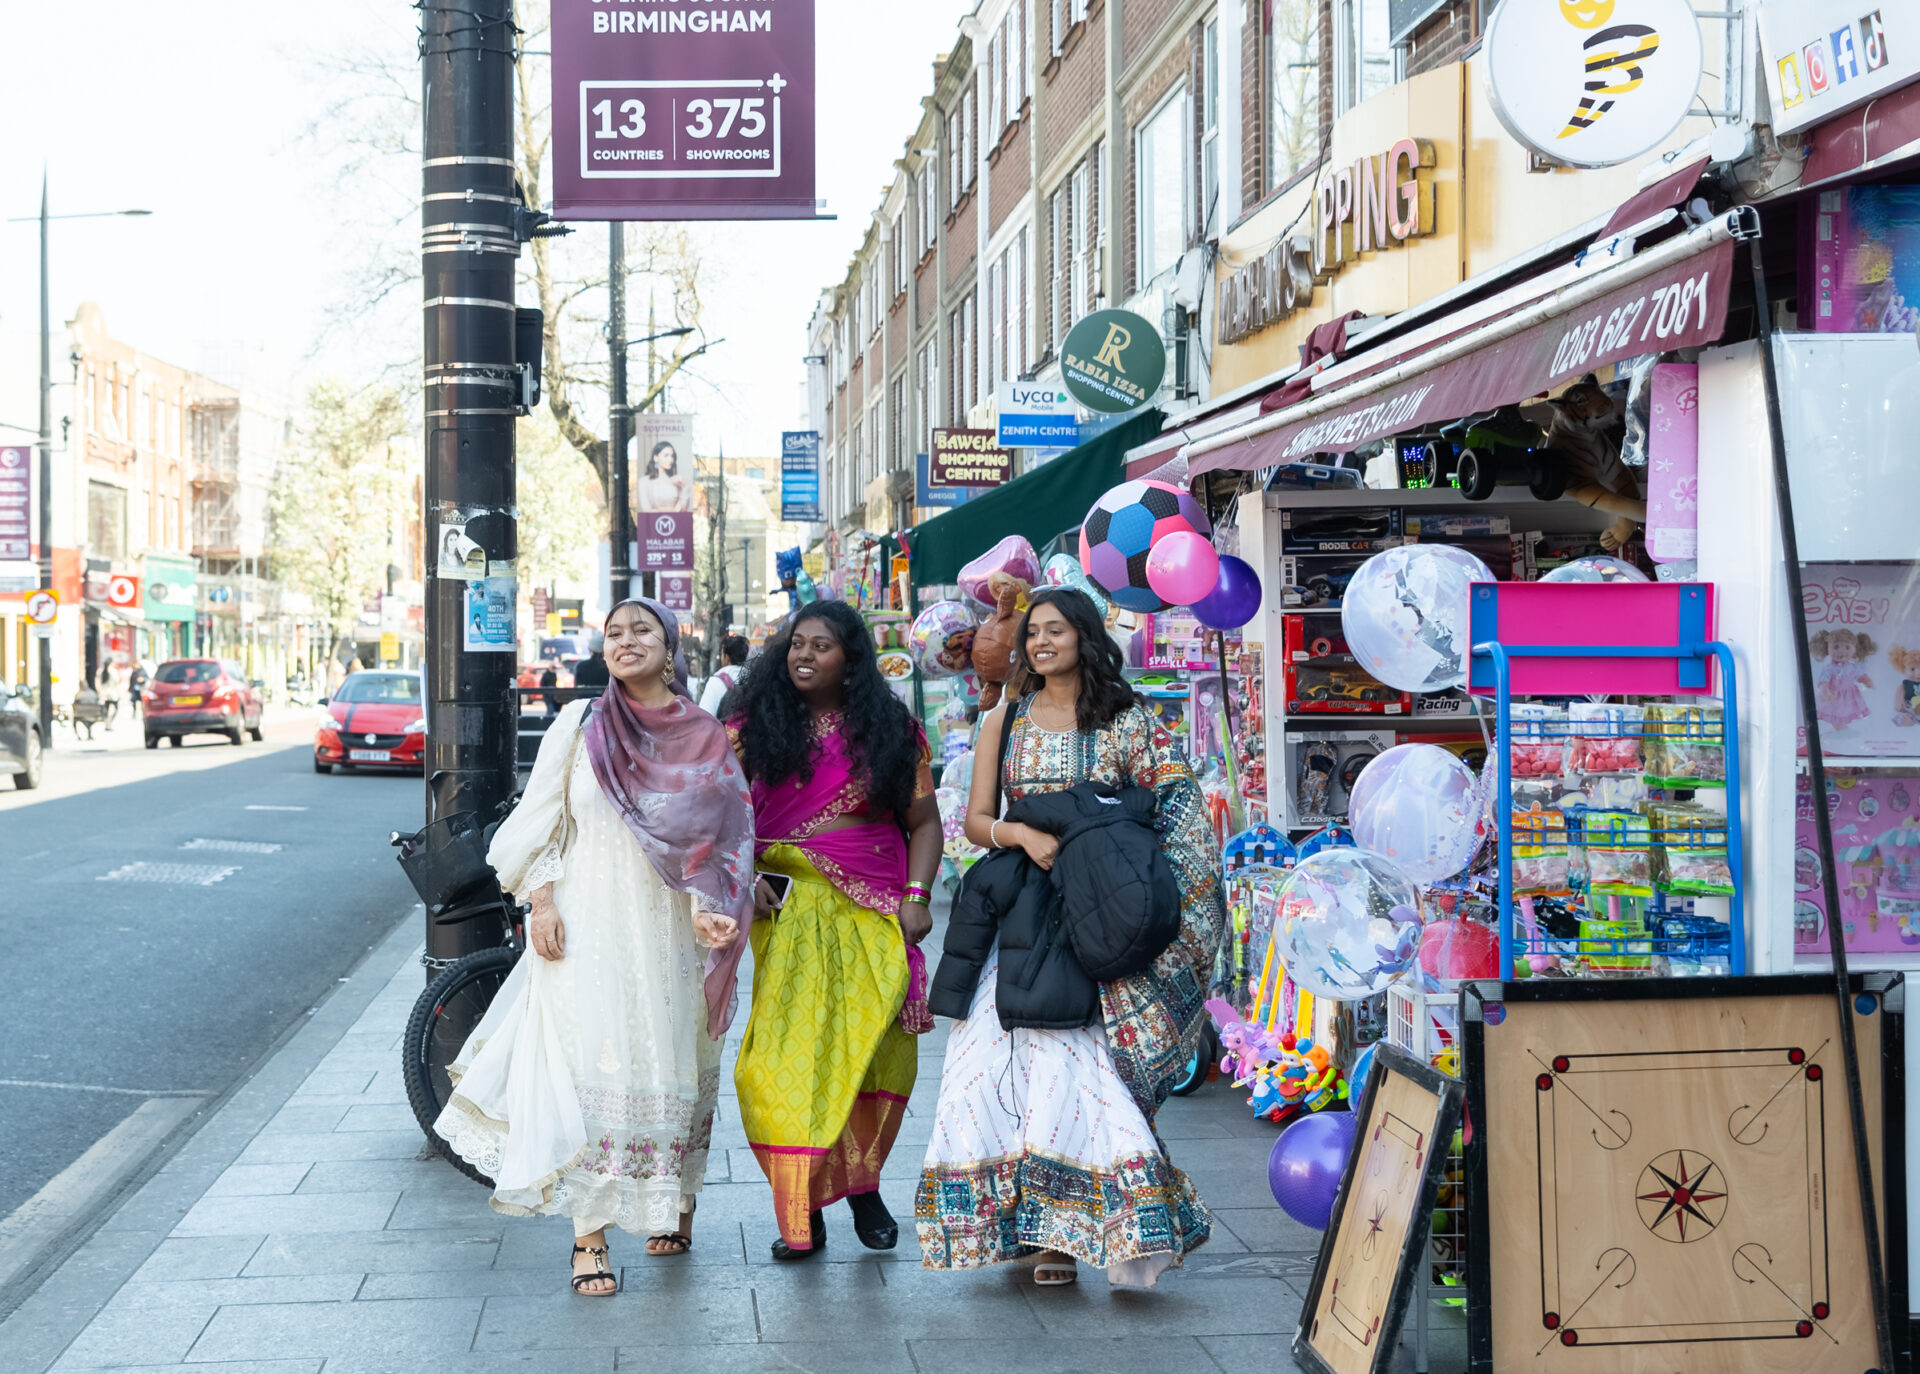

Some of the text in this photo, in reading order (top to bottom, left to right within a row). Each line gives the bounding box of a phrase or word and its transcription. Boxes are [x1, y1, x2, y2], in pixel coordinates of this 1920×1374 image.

[593, 10, 772, 33] BIRMINGHAM
[592, 99, 646, 139] 13
[685, 98, 766, 138] 375
[593, 150, 664, 160] COUNTRIES
[686, 149, 770, 160] SHOWROOMS
[1549, 271, 1709, 378] 0203 662 7081
[1064, 353, 1145, 401] RABIA IZZA
[1012, 387, 1054, 405] Lyca
[1066, 369, 1136, 407] SHOPPING CENTRE
[1002, 426, 1037, 435] ZENITH
[1040, 426, 1077, 436] CENTRE
[937, 434, 1009, 452] BAWEJA
[938, 452, 1009, 467] SHOPPING
[945, 467, 1001, 481] CENTRE
[928, 492, 957, 500] GREGGS
[1319, 541, 1369, 551] MODEL CAR
[1416, 696, 1461, 712] Racing
